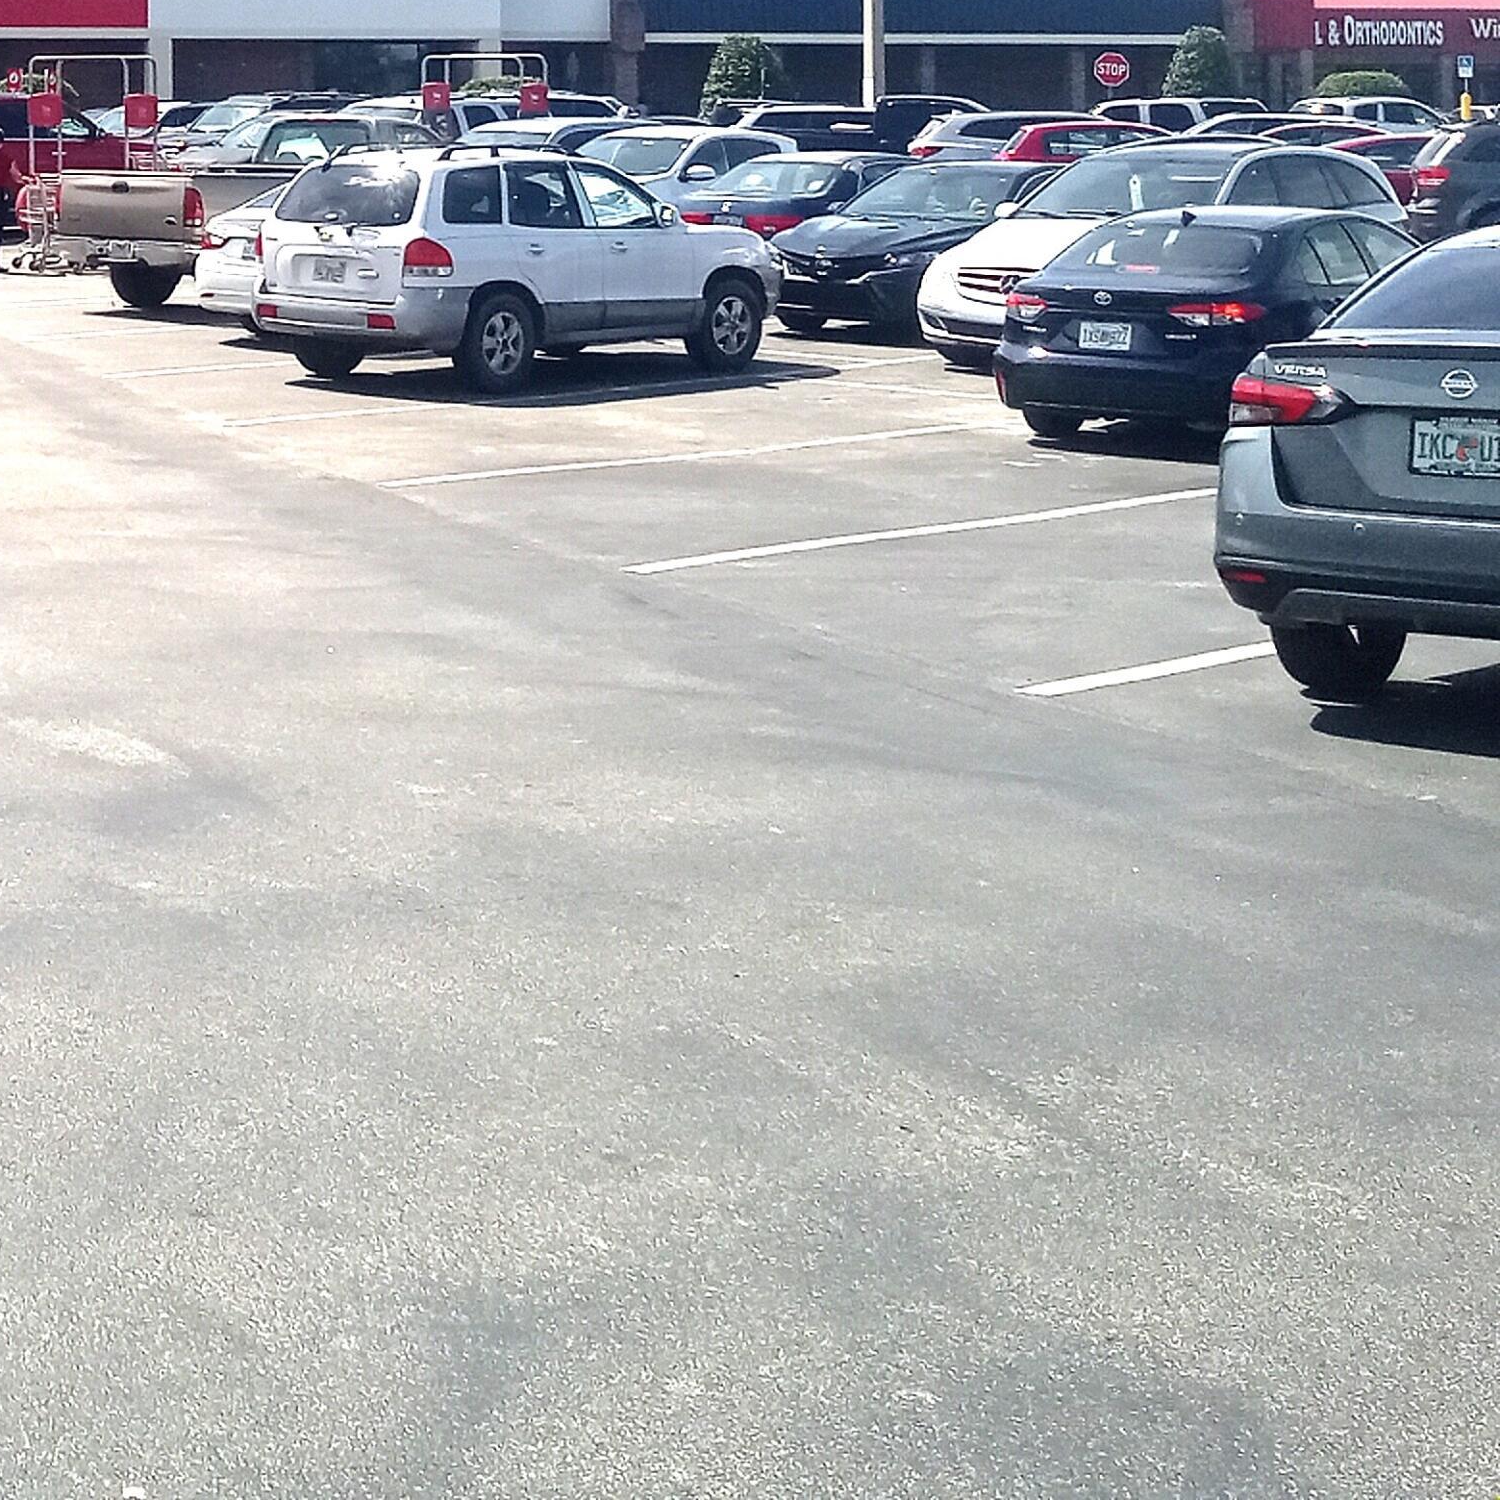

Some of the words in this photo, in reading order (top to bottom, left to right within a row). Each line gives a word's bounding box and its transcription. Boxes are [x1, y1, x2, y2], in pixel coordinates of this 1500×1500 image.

[1328, 19, 1340, 46] &
[1469, 17, 1500, 40] Wi
[1097, 62, 1126, 77] STOP
[1274, 364, 1327, 378] VERSA
